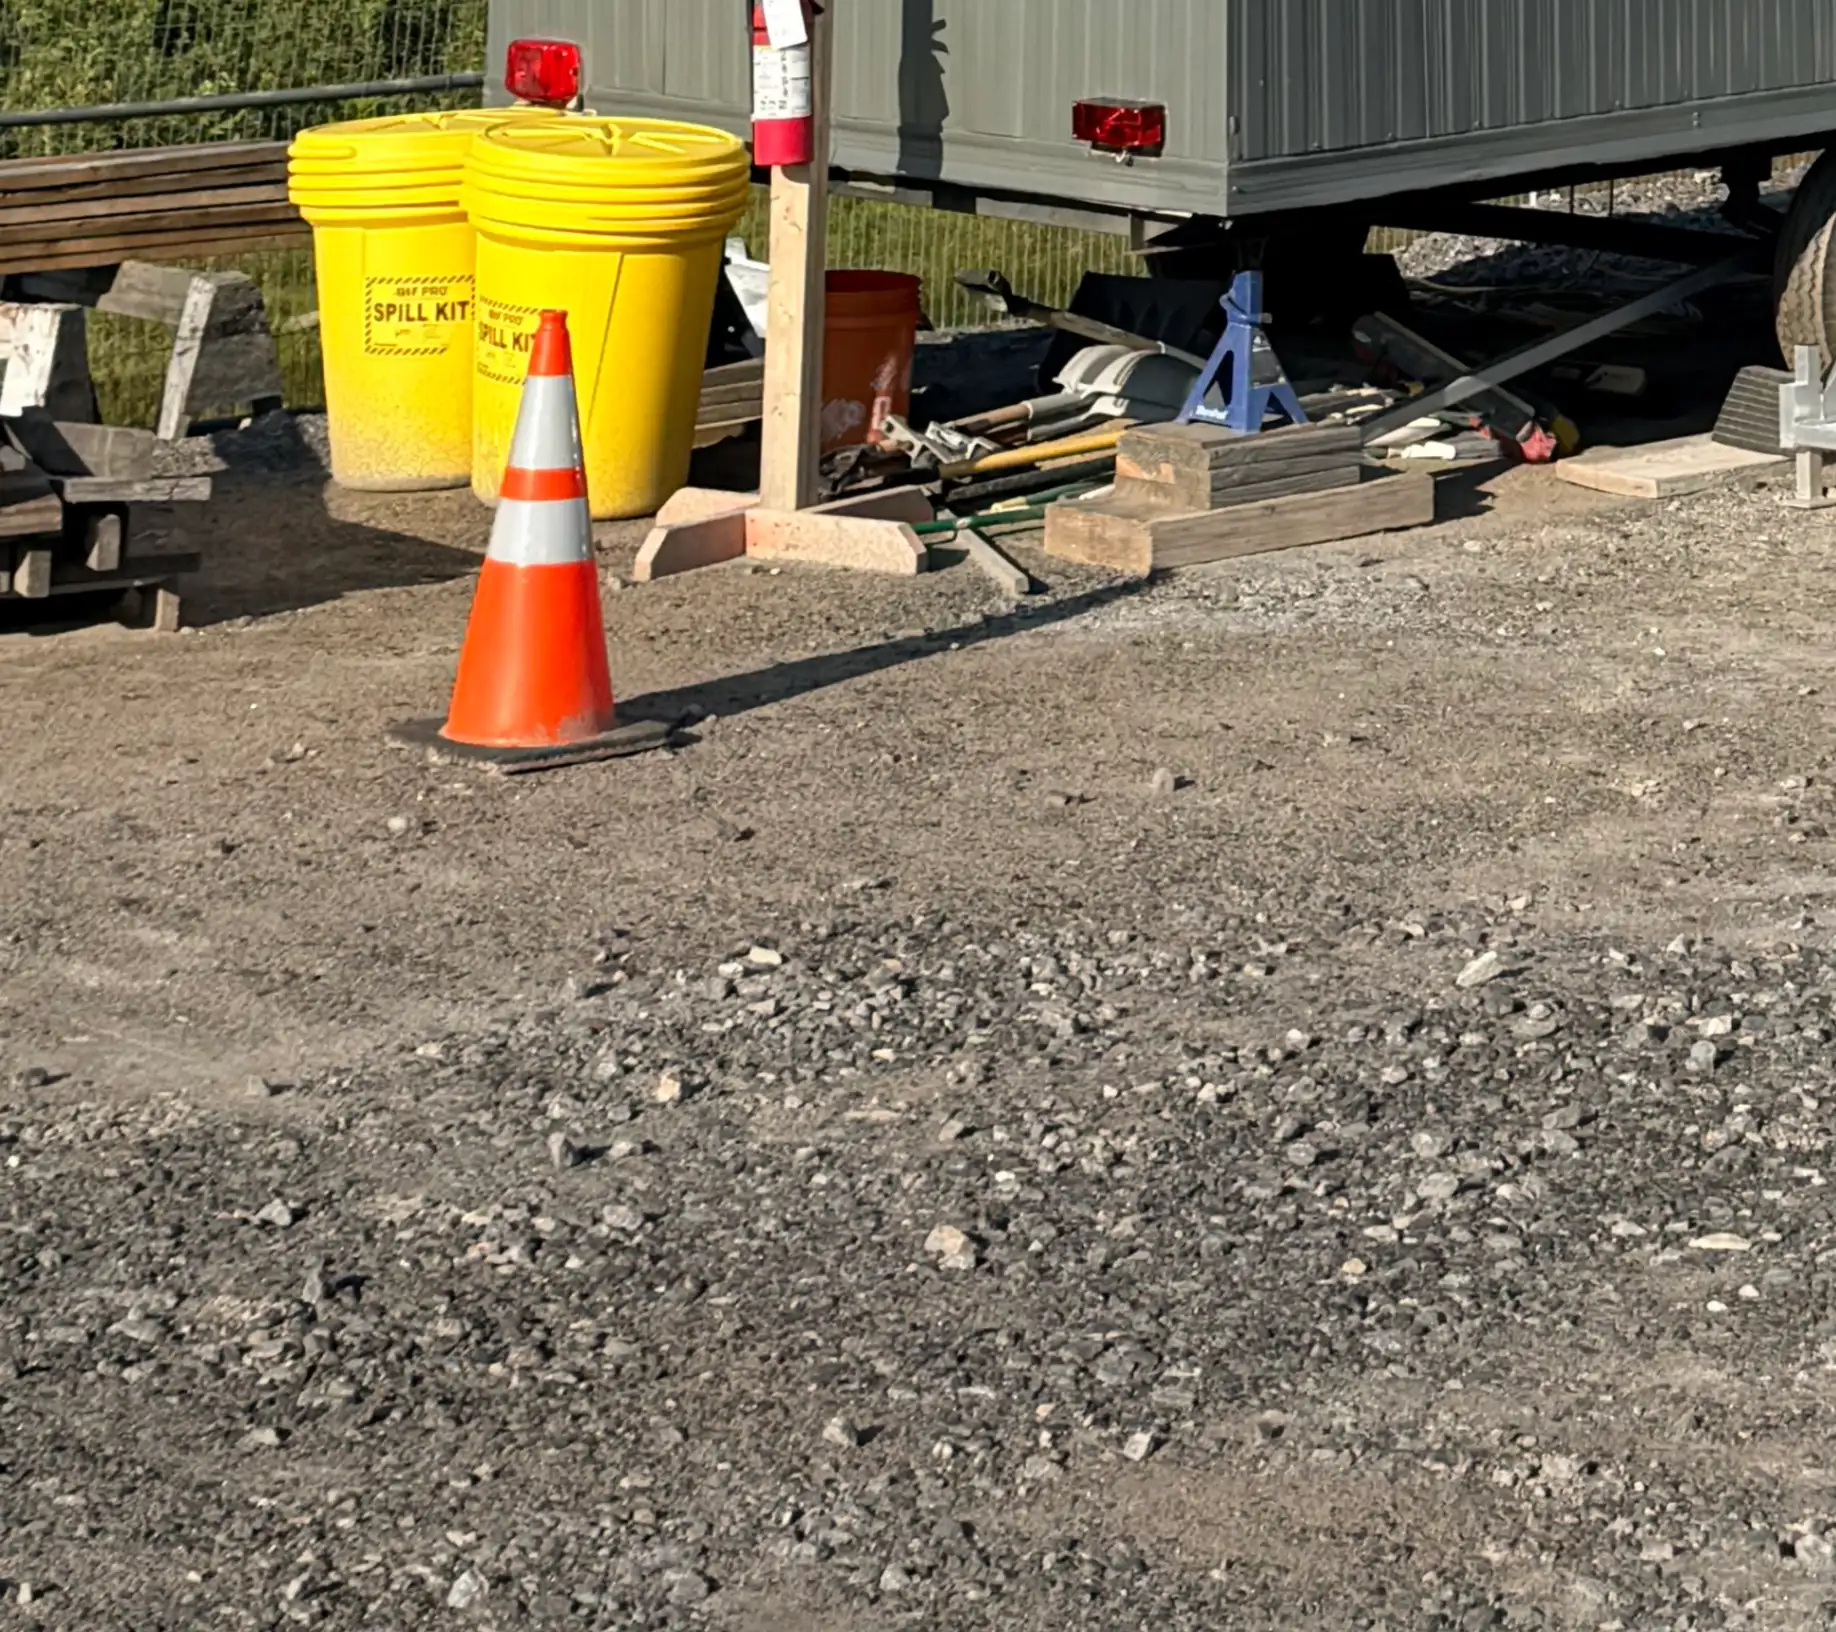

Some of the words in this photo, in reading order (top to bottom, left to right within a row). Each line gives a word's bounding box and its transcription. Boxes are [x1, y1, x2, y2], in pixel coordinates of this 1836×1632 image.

[374, 302, 428, 322] SPILL
[435, 300, 469, 321] KIT
[479, 321, 507, 349] SPILL
